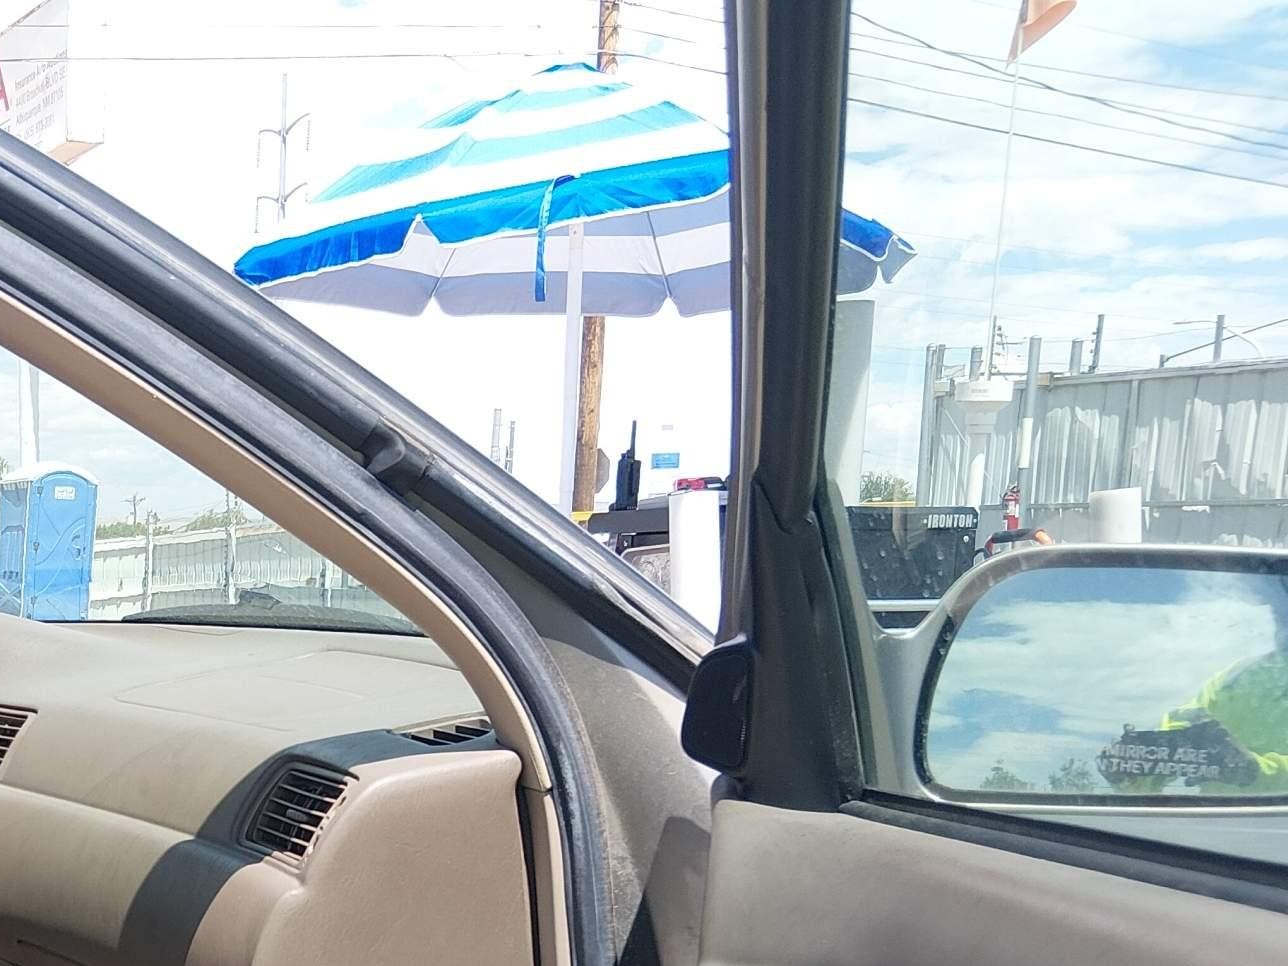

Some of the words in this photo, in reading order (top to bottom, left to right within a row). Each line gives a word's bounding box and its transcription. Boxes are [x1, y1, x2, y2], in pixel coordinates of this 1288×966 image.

[927, 514, 973, 529] IRONTON
[1105, 744, 1170, 761] MIRROR
[1173, 747, 1209, 763] ARE
[1109, 758, 1154, 774] THEY
[1153, 761, 1220, 779] APPEAR
